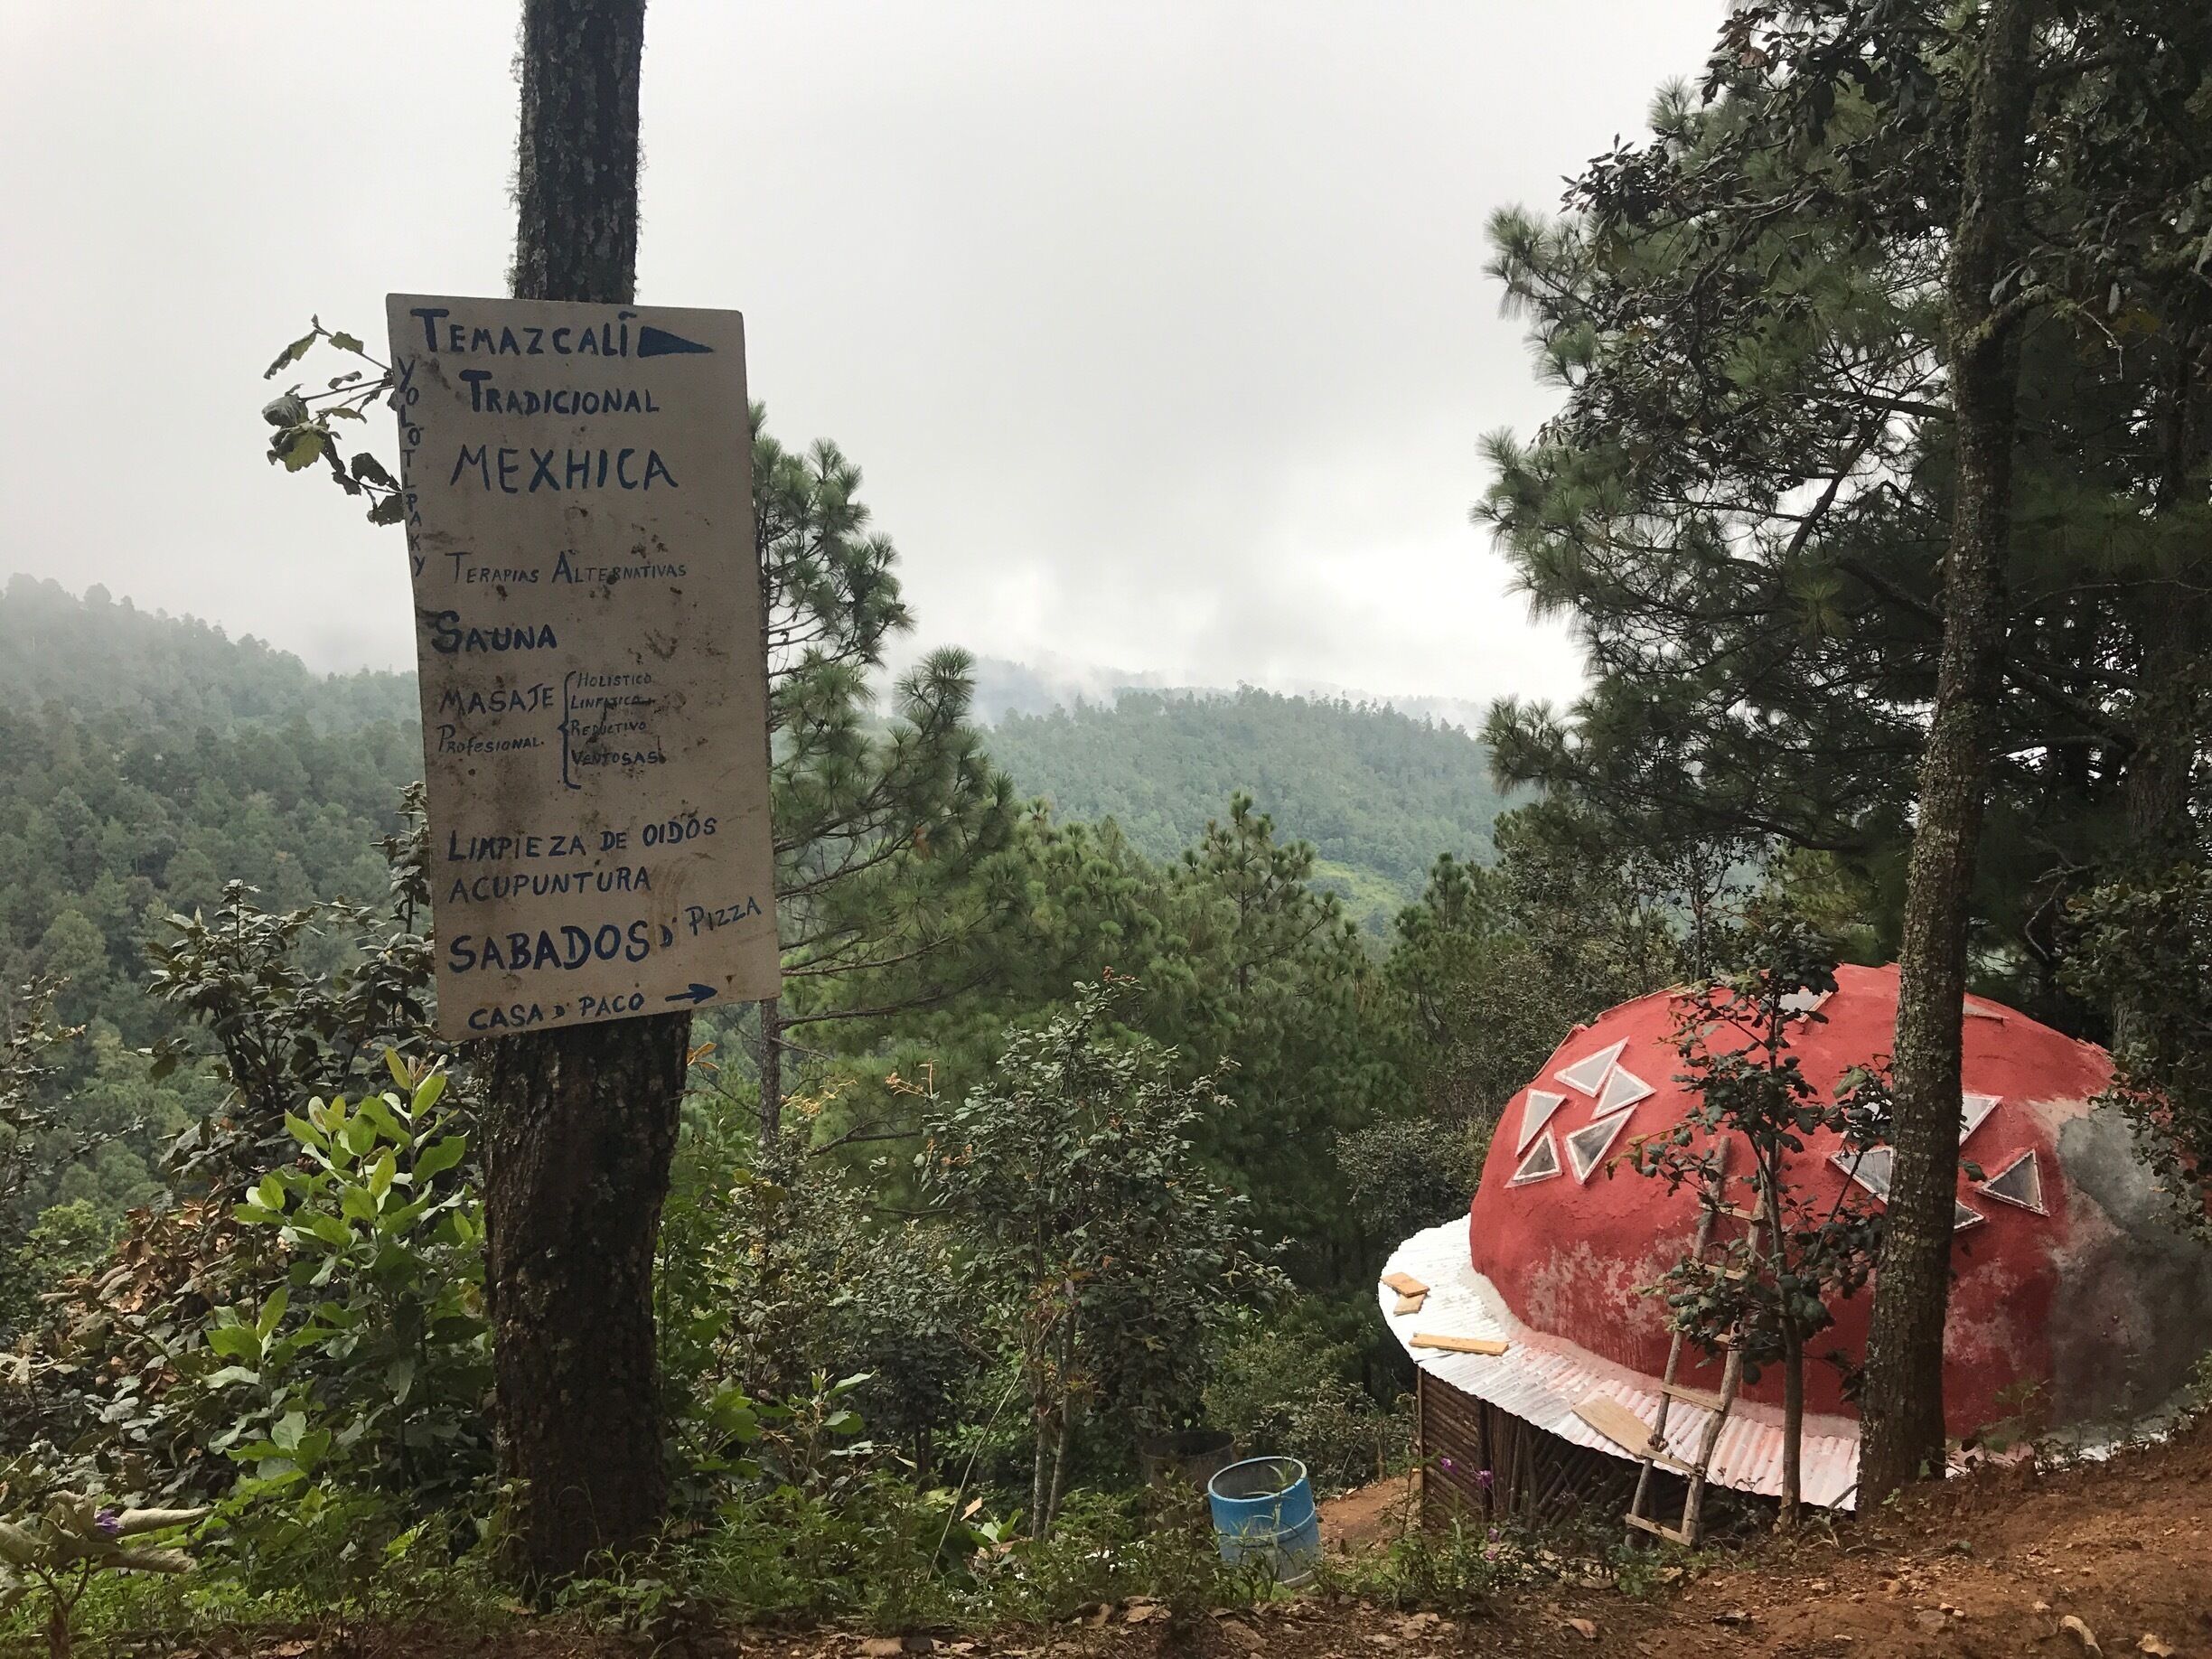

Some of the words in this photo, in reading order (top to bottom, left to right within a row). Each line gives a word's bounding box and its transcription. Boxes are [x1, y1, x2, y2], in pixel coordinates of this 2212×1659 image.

[459, 369, 660, 415] TRADICIONAL
[450, 444, 679, 493] MEXHICA
[445, 551, 539, 584] TERAPIAS
[551, 550, 687, 584] ALTERNATIVAS
[431, 610, 558, 654] SAUNA
[577, 671, 651, 688] HOLISTICO
[438, 683, 555, 716] MASAJE
[570, 719, 647, 736] REDUCTIVO
[448, 830, 586, 862] LIMPIEZA
[600, 830, 627, 852] DE
[642, 817, 717, 847] OIDOS
[448, 867, 651, 904] ACUPUNTURA
[448, 920, 651, 973] SABADOS
[685, 896, 762, 936] PIZZA
[468, 1003, 544, 1031] CASA
[578, 992, 645, 1017] PACO
